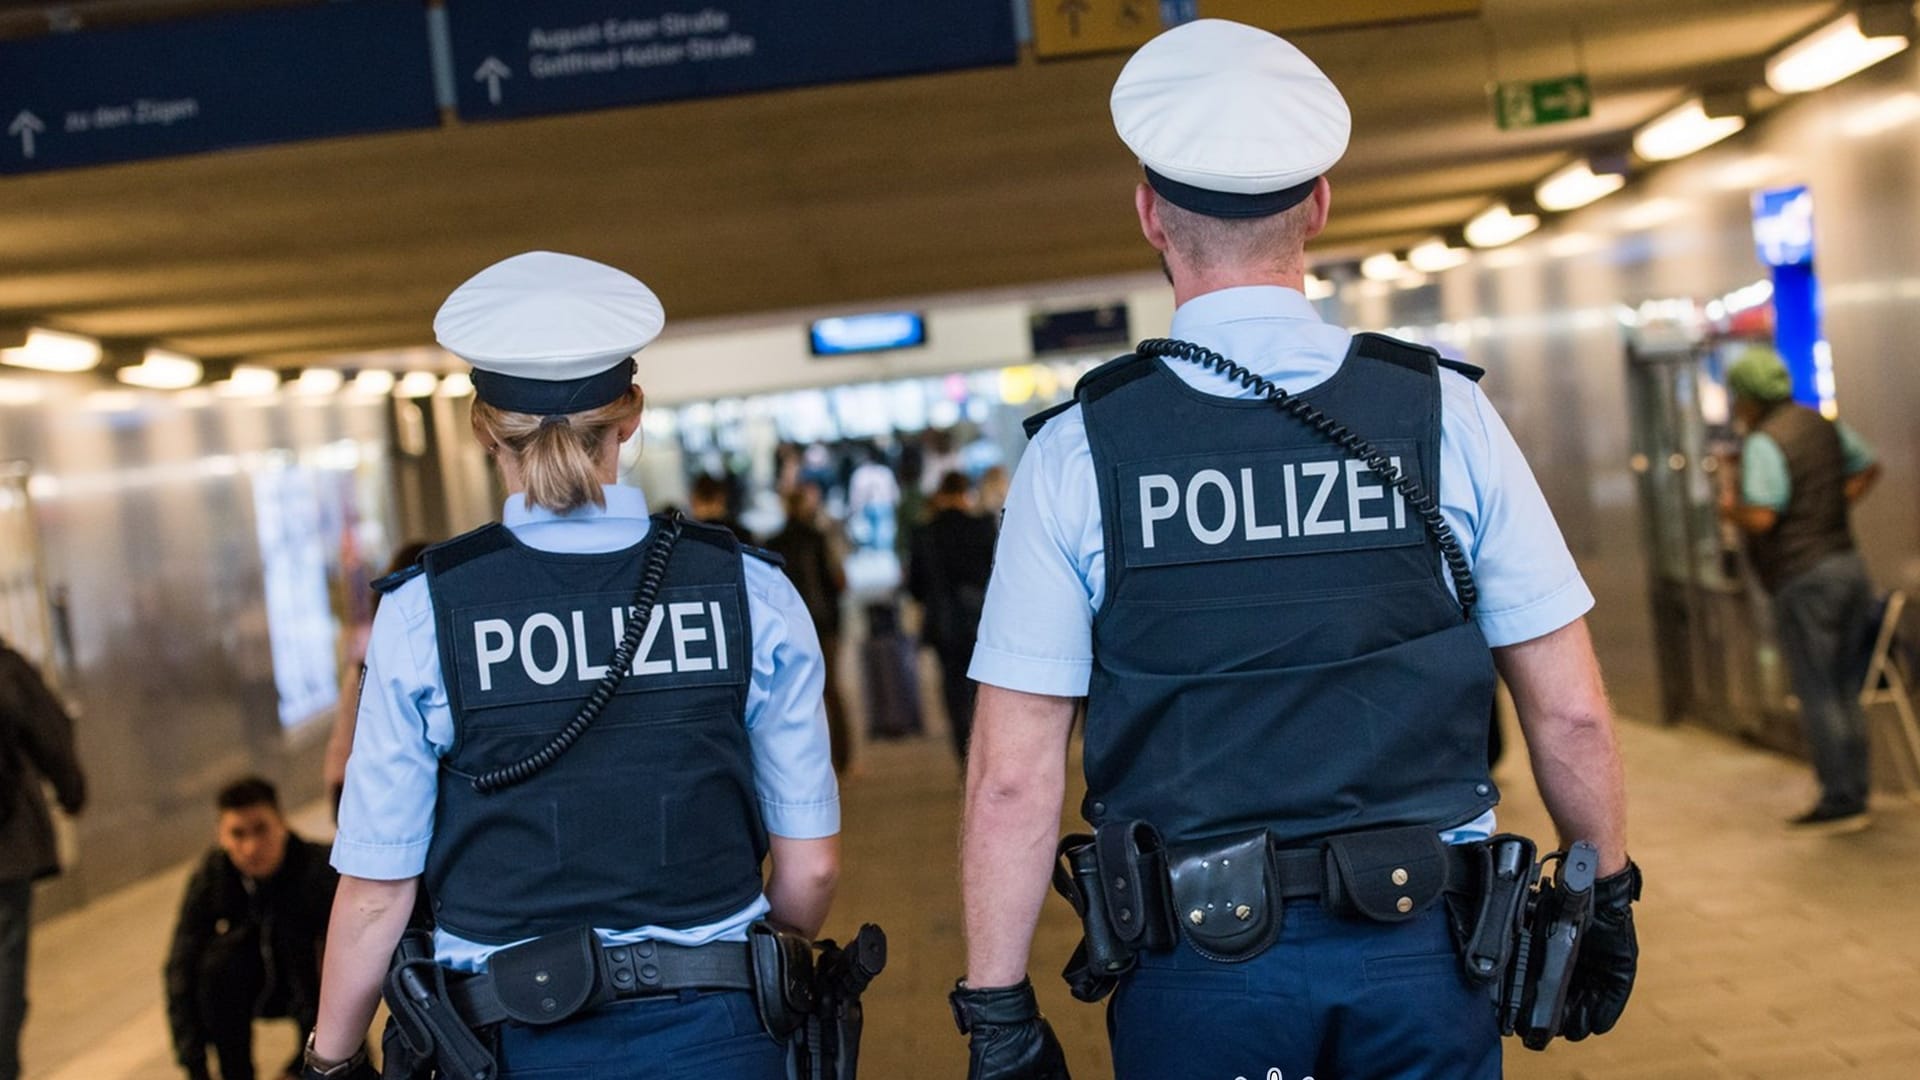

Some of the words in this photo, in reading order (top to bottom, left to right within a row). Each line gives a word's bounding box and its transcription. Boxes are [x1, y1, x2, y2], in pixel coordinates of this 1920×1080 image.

[95, 105, 131, 128] den
[135, 99, 198, 125] Zügen
[1139, 456, 1406, 548] POLIZEI
[474, 601, 728, 691] POLIZEI
